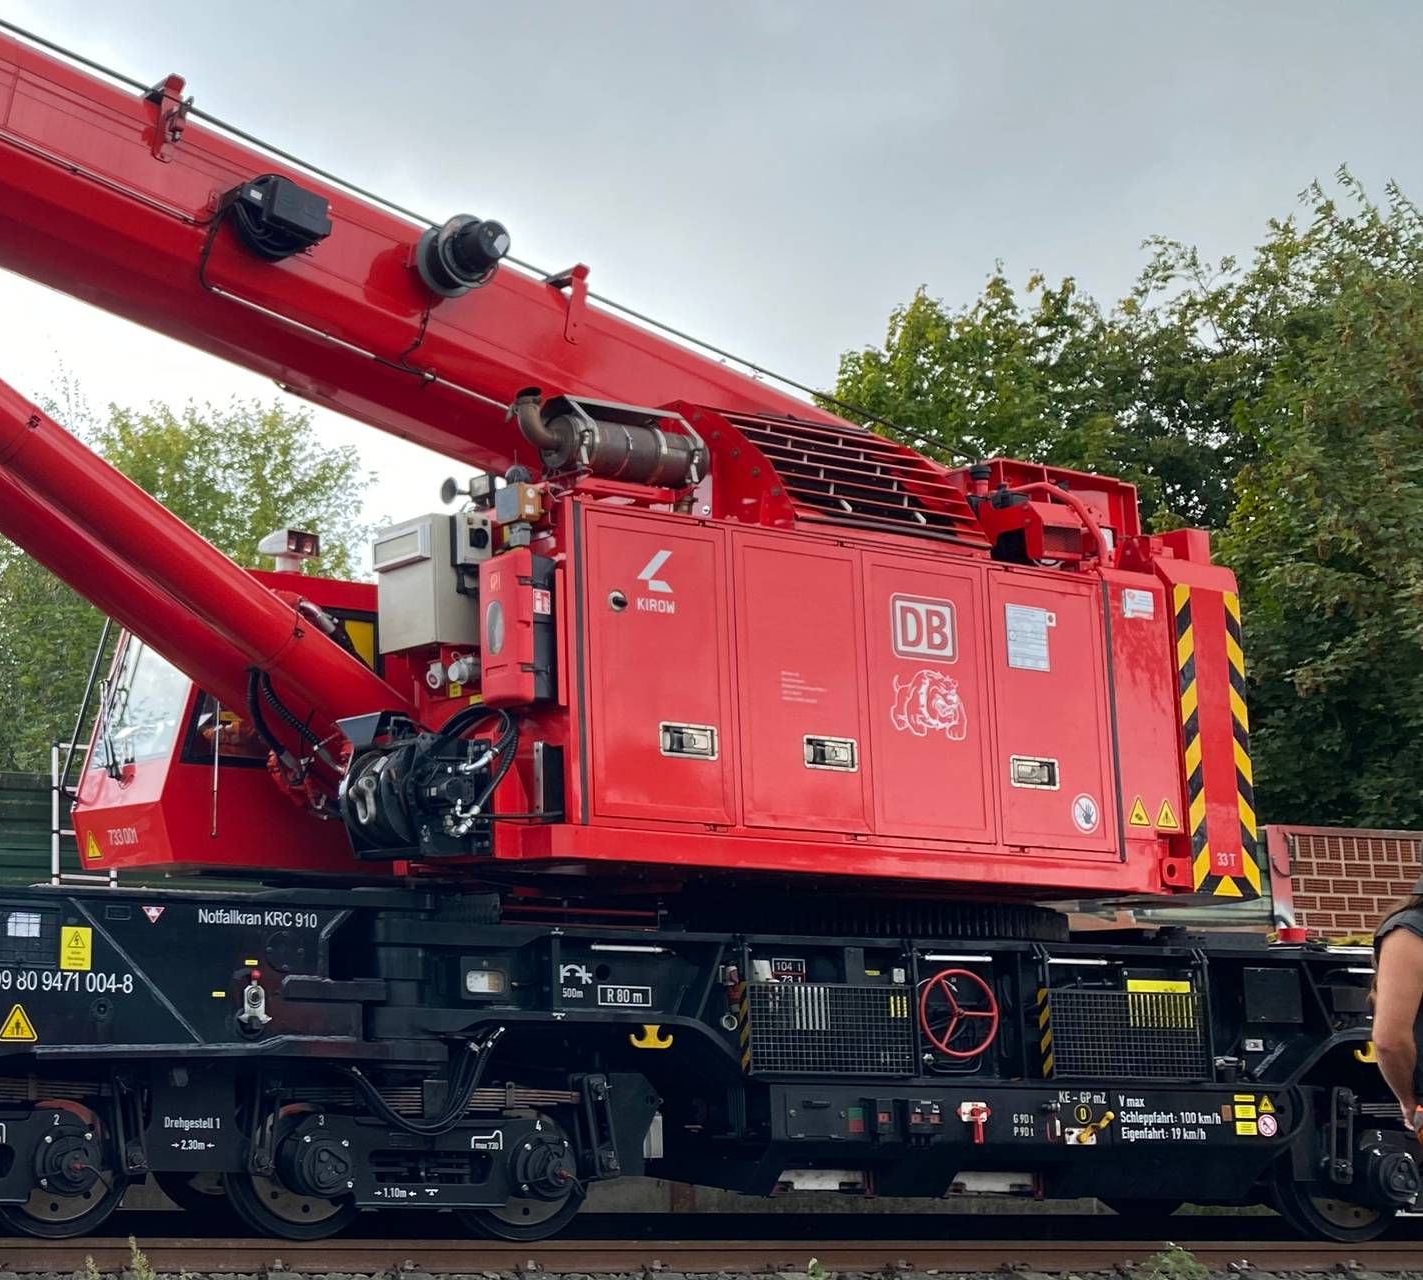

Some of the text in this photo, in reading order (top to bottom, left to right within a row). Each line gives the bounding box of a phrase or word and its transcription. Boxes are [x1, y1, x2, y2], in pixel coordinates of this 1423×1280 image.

[637, 597, 675, 614] KIROW
[900, 605, 949, 651] DB
[107, 828, 124, 845] 733
[198, 908, 317, 928] Notfallkran KRC 910
[776, 961, 792, 971] 104
[16, 971, 38, 991] 80
[41, 971, 80, 992] 9471
[85, 972, 134, 993] 004-8
[562, 988, 583, 998] 500m
[607, 988, 643, 1003] R 80 m
[1059, 1091, 1071, 1103] KE
[1080, 1092, 1091, 1103] GP
[1093, 1092, 1107, 1104] mZ
[1118, 1095, 1145, 1107] V max
[53, 1114, 60, 1125] 2
[164, 1117, 221, 1131] Drehgestell 1
[319, 1115, 325, 1126] 3
[1013, 1114, 1019, 1124] G
[1020, 1114, 1029, 1124] 90
[1120, 1110, 1178, 1126] Schleppfahrt:
[1180, 1111, 1197, 1124] 100
[1198, 1112, 1222, 1125] km/h
[535, 1120, 542, 1131] 4
[1013, 1127, 1019, 1137] P
[1020, 1127, 1030, 1137] 90
[1121, 1126, 1207, 1142] Eigenfahrt: 19 km/h
